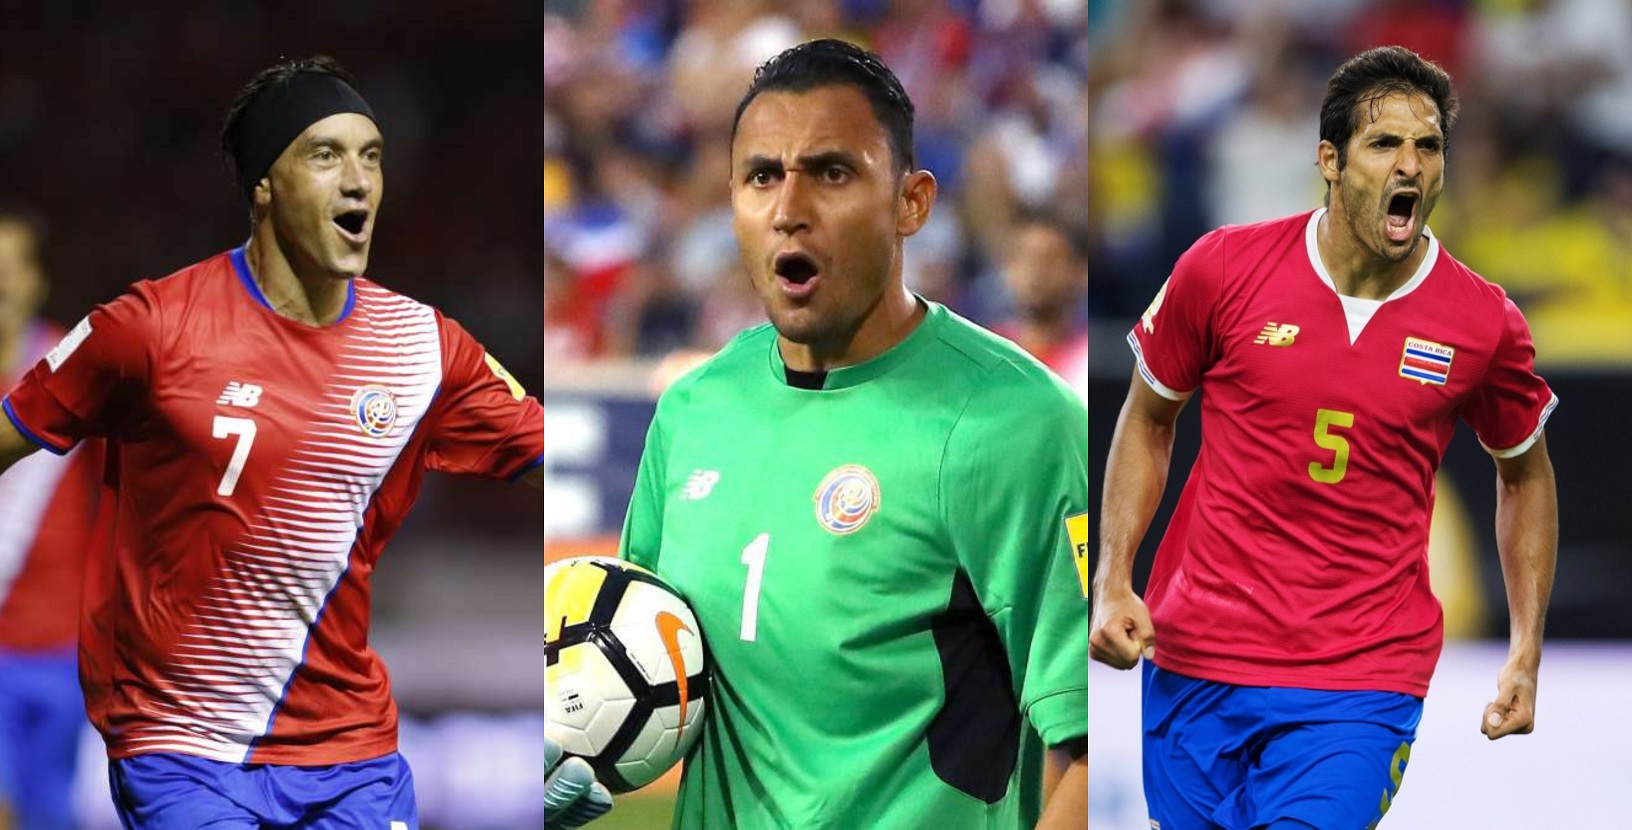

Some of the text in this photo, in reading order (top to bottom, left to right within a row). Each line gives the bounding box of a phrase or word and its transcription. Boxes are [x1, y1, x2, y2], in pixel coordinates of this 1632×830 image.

[1254, 322, 1300, 346] NB
[1408, 341, 1452, 357] COSTA RICA
[212, 415, 257, 496] 7
[1308, 408, 1354, 484] 5
[739, 532, 769, 642] 1
